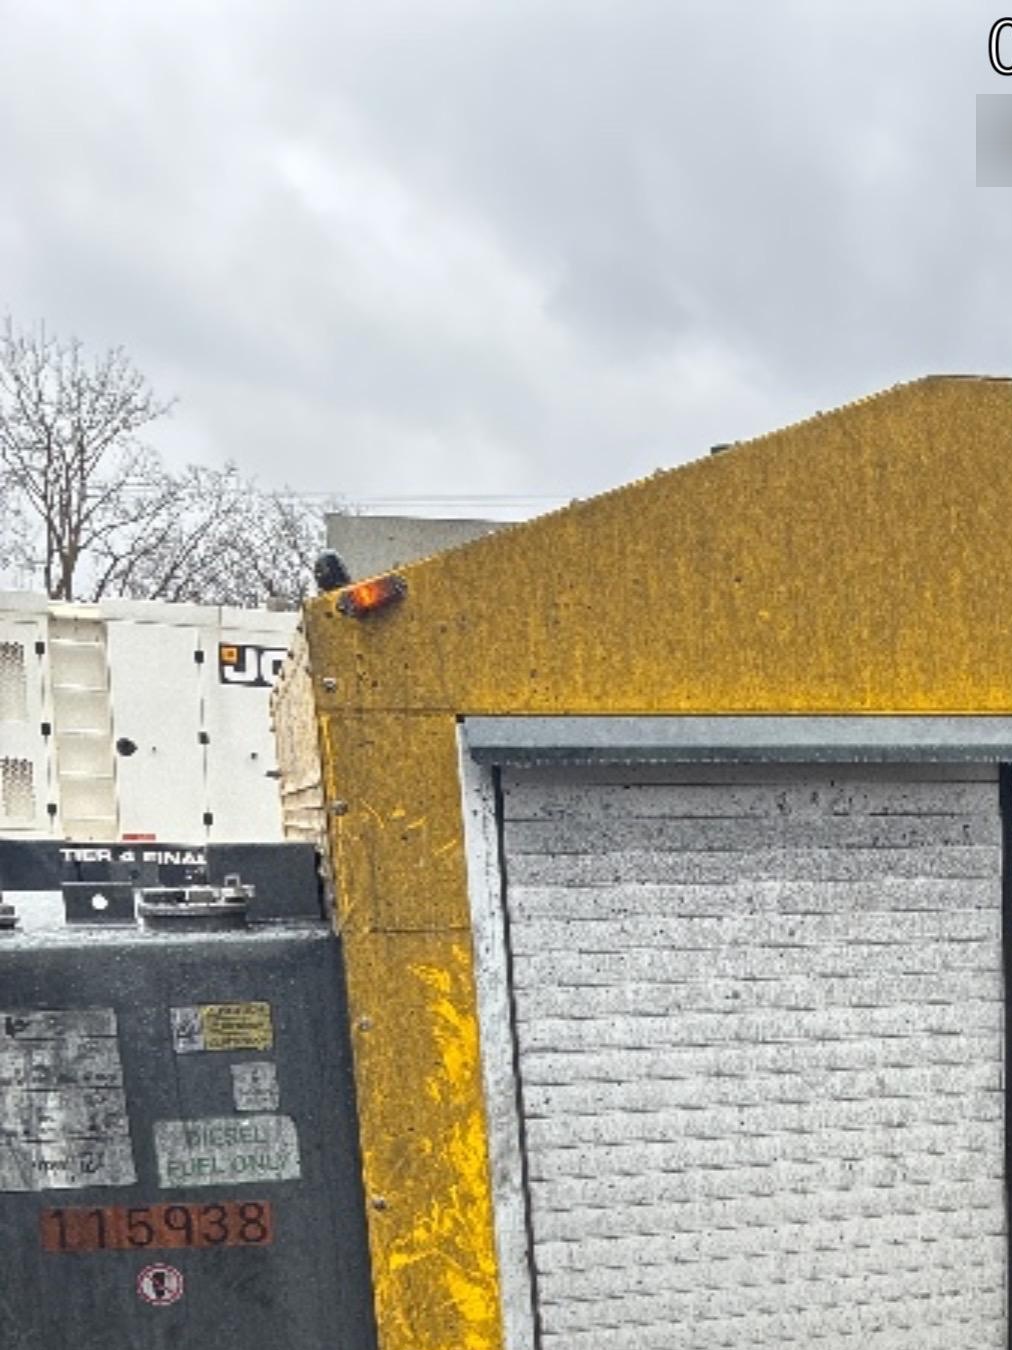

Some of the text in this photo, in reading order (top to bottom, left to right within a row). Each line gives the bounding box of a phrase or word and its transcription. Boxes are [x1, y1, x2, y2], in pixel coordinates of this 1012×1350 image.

[59, 848, 208, 865] TIER 4 FINAL
[185, 1126, 267, 1147] DIESEL
[166, 1153, 287, 1176] FUEL ONLY
[50, 1202, 267, 1249] 115938
